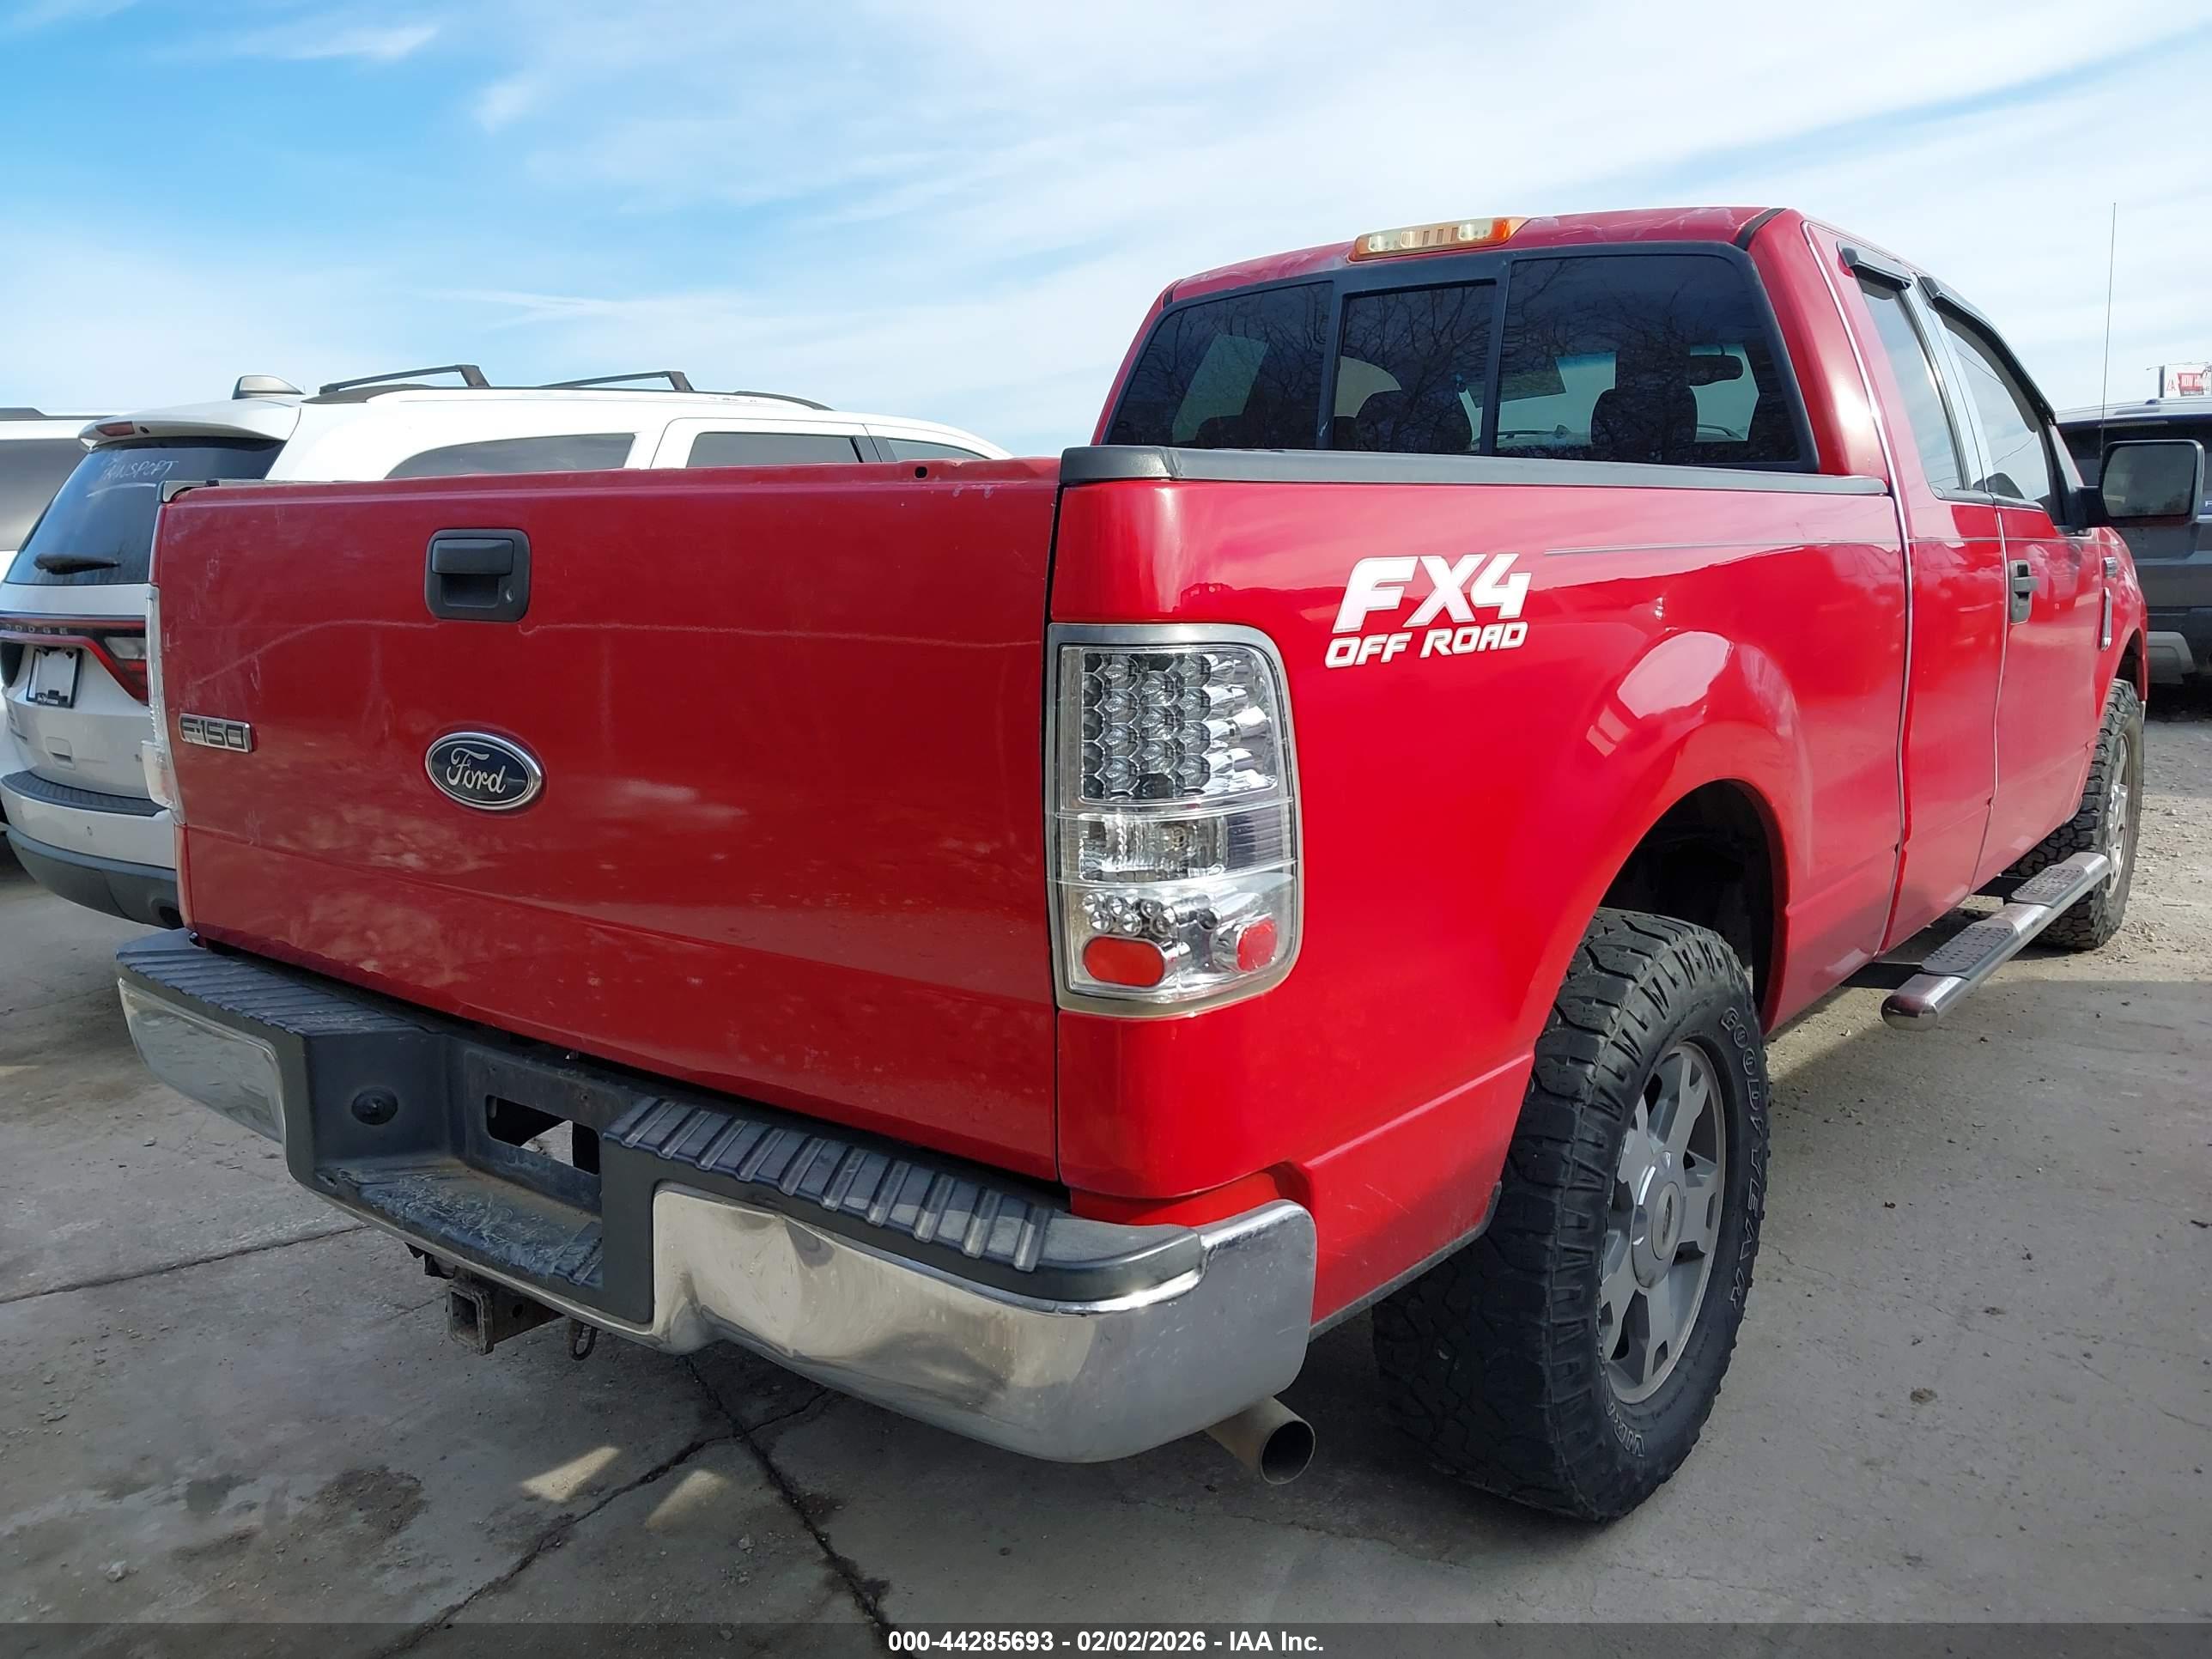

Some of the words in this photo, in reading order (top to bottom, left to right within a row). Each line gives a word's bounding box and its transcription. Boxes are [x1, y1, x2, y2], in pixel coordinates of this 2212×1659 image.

[1332, 552, 1533, 634] FX4
[1324, 631, 1413, 669] OFF
[1419, 621, 1529, 659] ROAD
[446, 747, 507, 794] Ford
[1719, 1006, 1765, 1312] GOODYEAR
